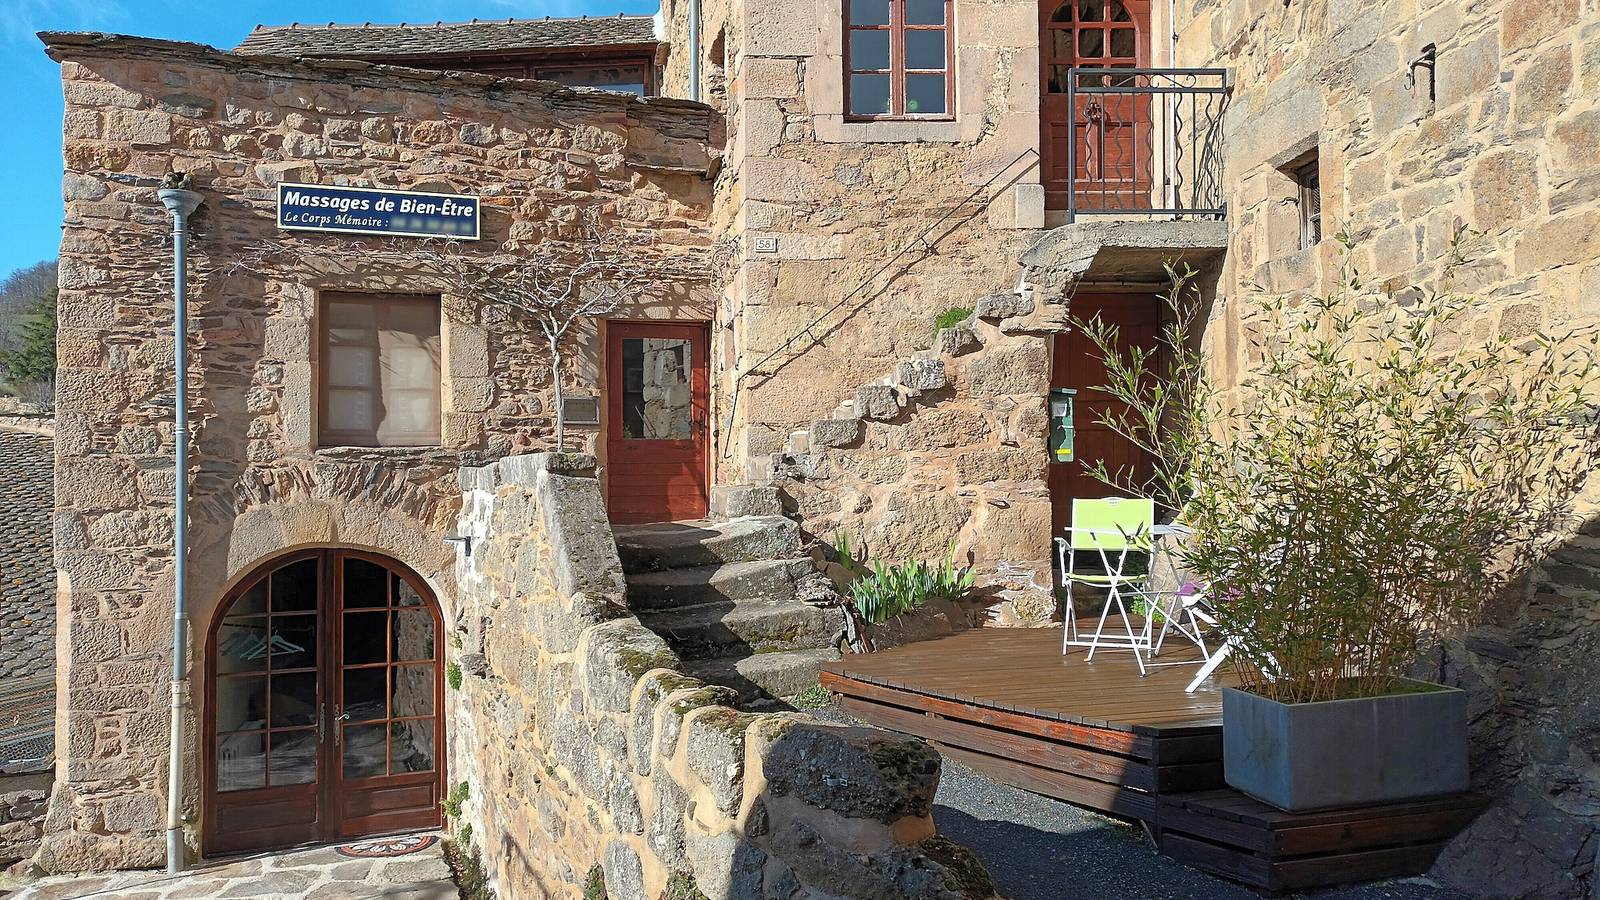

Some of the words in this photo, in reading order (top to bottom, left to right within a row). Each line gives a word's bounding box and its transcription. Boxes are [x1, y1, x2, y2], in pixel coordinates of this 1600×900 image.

[284, 191, 370, 213] Massages
[375, 197, 395, 212] de
[400, 198, 473, 217] Bien-Être
[283, 211, 298, 222] Le
[301, 212, 331, 227] Corps
[335, 213, 382, 227] Mémoire
[759, 239, 771, 249] 58
